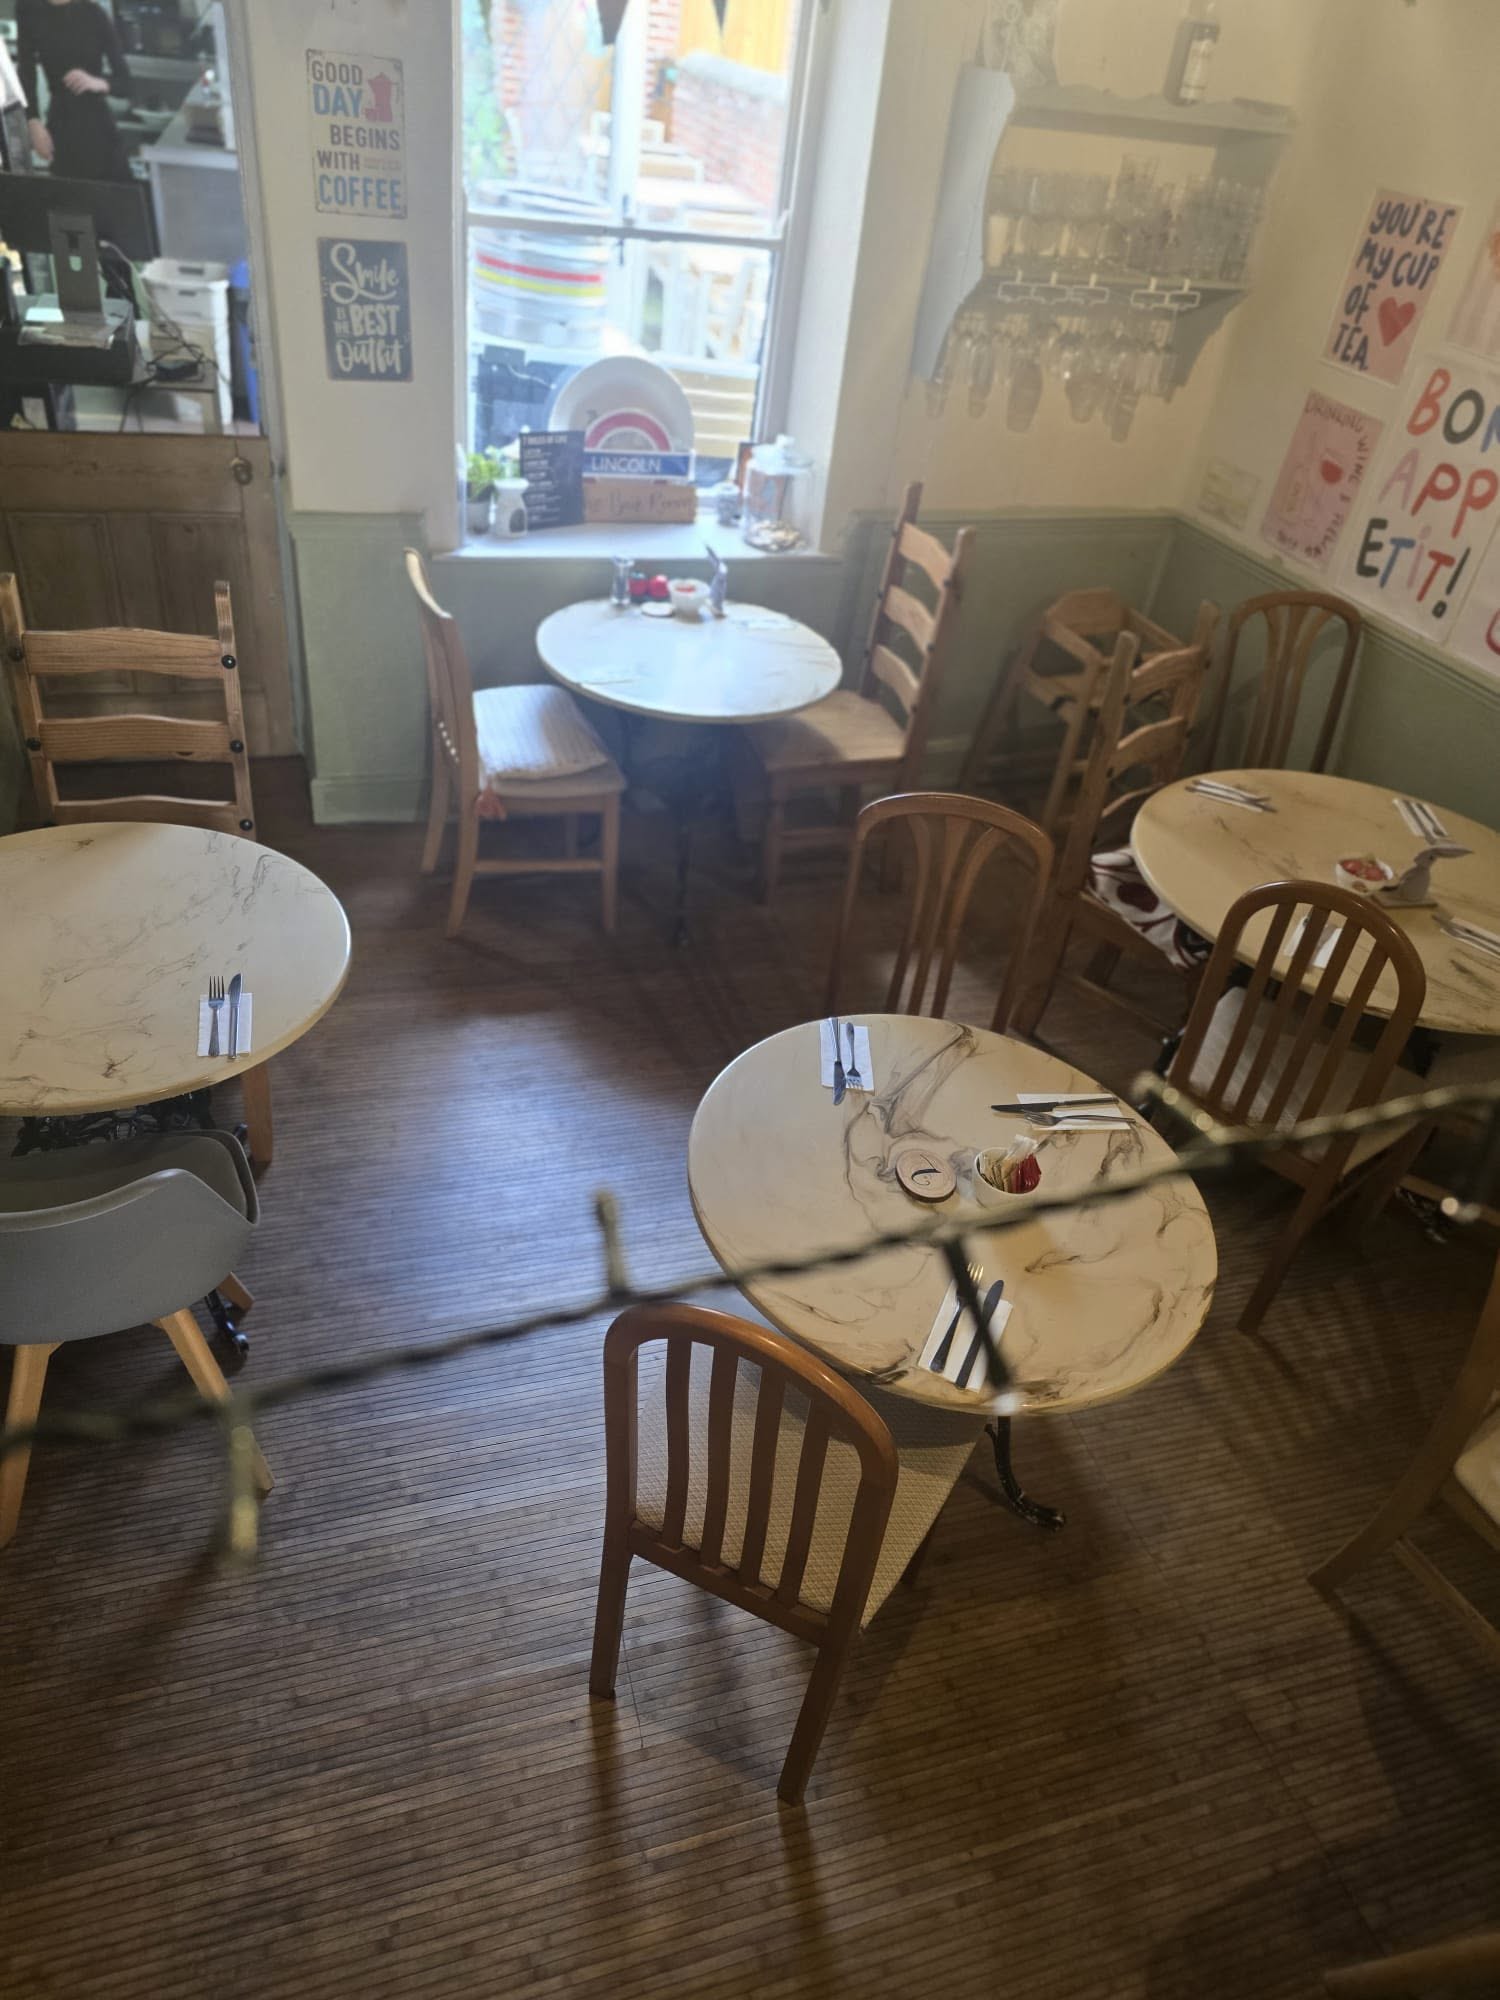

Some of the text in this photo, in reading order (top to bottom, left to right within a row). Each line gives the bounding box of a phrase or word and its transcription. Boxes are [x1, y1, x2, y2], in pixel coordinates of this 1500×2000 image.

[311, 60, 363, 86] GOOD
[312, 83, 363, 118] DAY
[330, 123, 401, 151] BEGINS
[316, 149, 360, 171] WITH
[318, 173, 401, 210] COFFEE
[329, 242, 400, 305] Smile
[1356, 237, 1440, 290] MY CUP
[350, 303, 401, 336] BEST
[1344, 282, 1377, 325] OF
[591, 455, 662, 473] LINCOLN
[1378, 447, 1499, 539] APP
